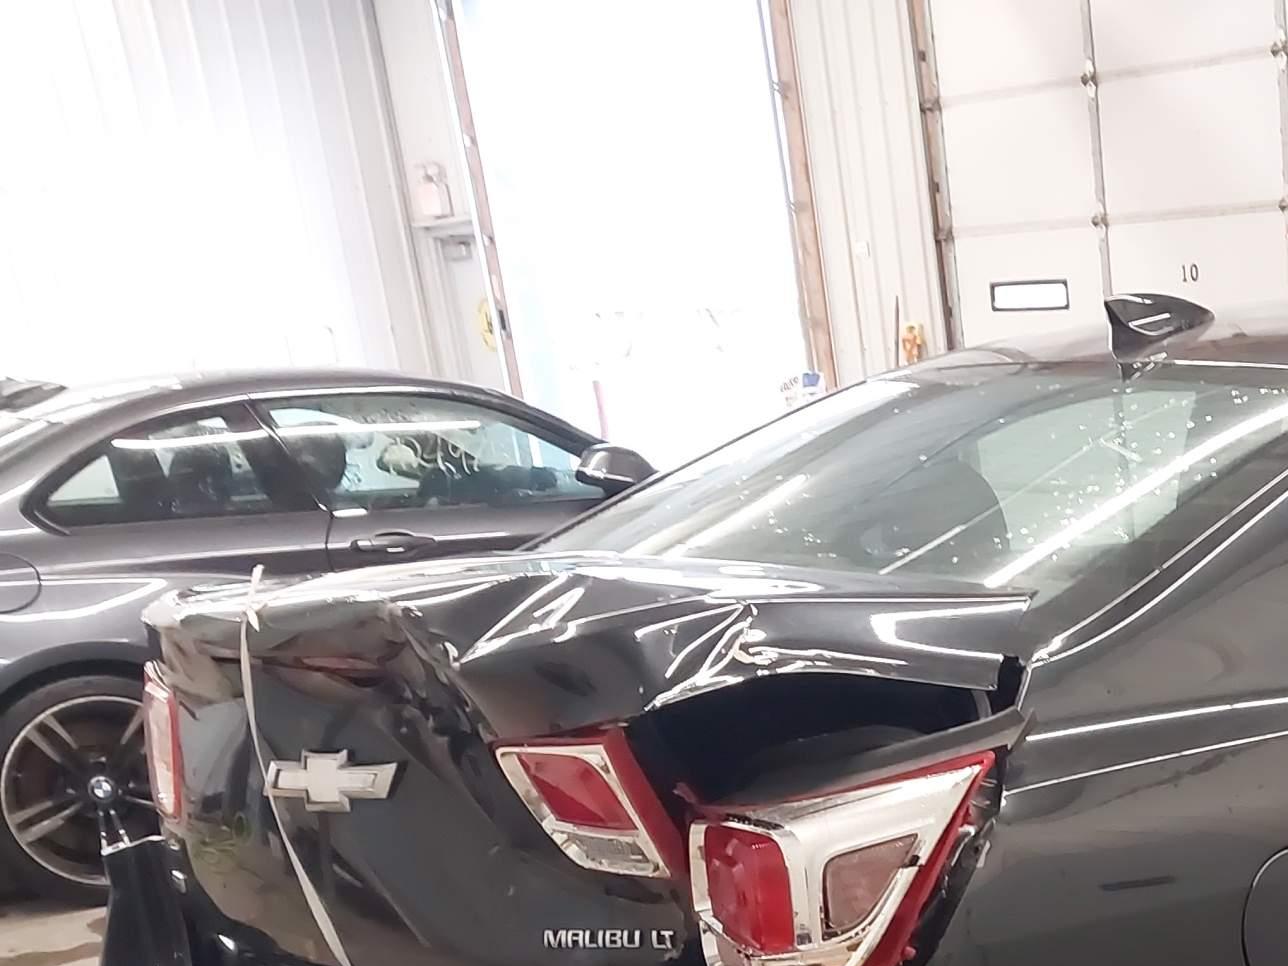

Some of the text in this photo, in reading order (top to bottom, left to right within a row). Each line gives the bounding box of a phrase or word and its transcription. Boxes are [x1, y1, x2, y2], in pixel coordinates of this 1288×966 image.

[1181, 263, 1199, 282] 10
[543, 929, 674, 949] MALIBU LT
